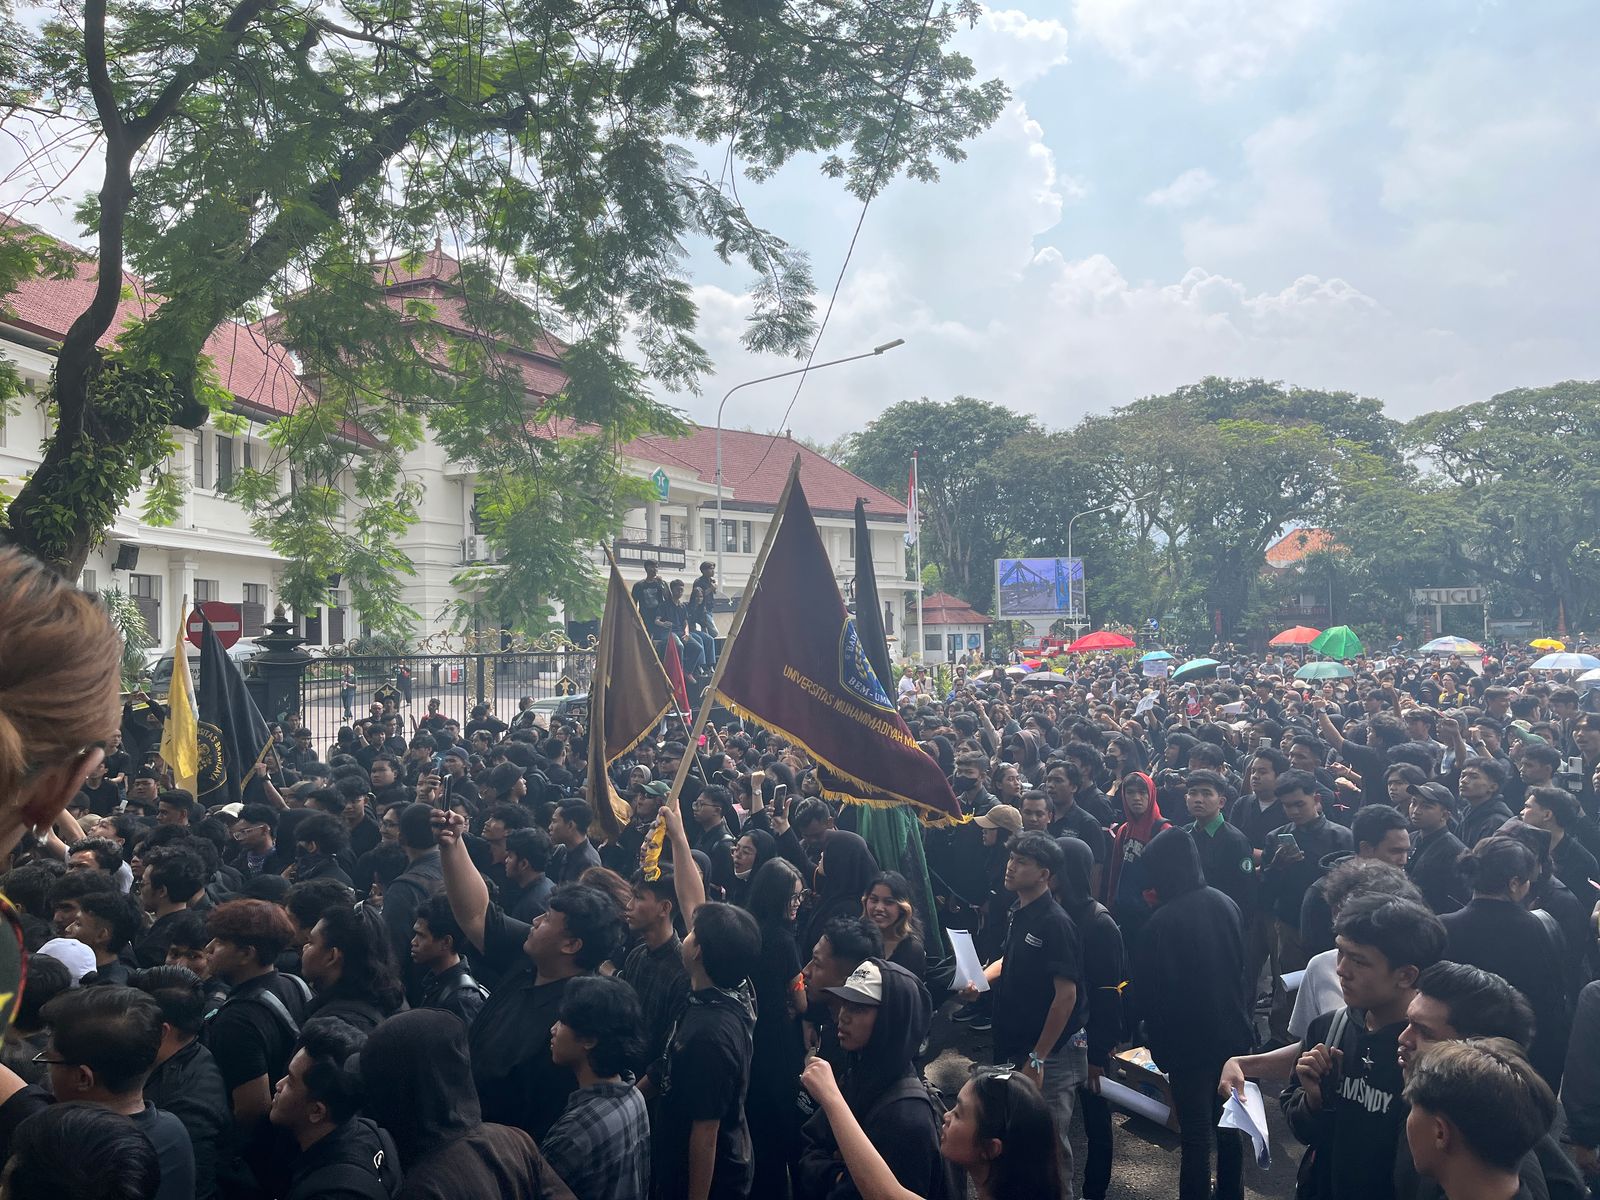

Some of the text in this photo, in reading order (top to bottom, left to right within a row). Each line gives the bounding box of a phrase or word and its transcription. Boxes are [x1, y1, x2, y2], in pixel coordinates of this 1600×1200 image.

[783, 664, 920, 751] UNIVERSITAS MUHAMMADIYAH MA
[198, 727, 218, 743] SITAS
